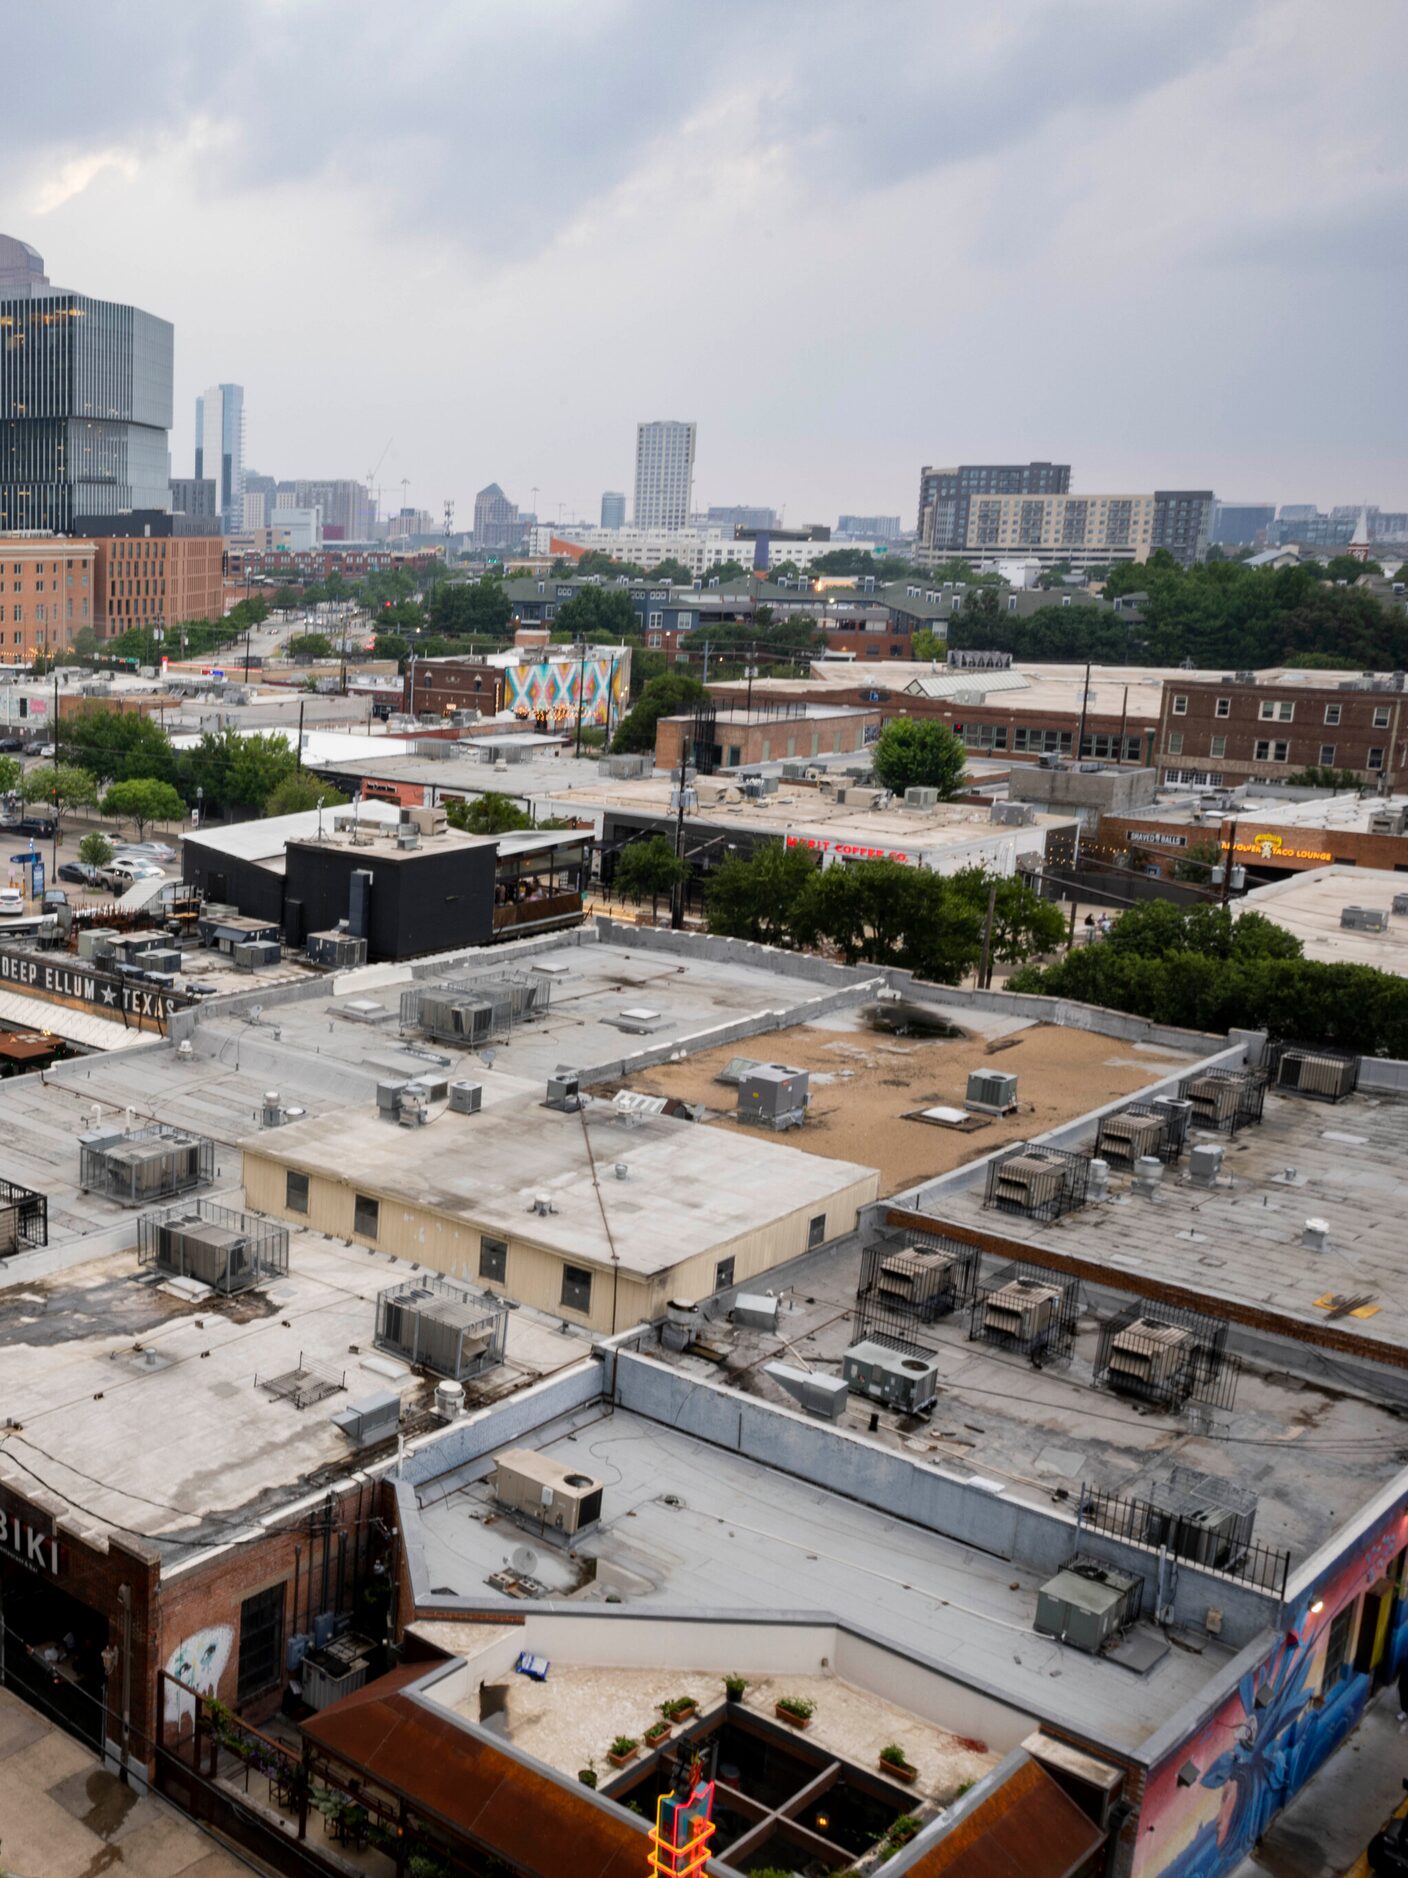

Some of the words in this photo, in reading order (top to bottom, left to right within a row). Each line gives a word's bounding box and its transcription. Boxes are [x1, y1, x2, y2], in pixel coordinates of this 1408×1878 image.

[1130, 832, 1154, 842] SHAVED
[1272, 846, 1295, 857] TACO
[1296, 850, 1332, 862] LOUNGE
[1, 955, 38, 984] DEEP
[45, 967, 95, 1001] ELLUM
[123, 988, 175, 1019] TEXAS
